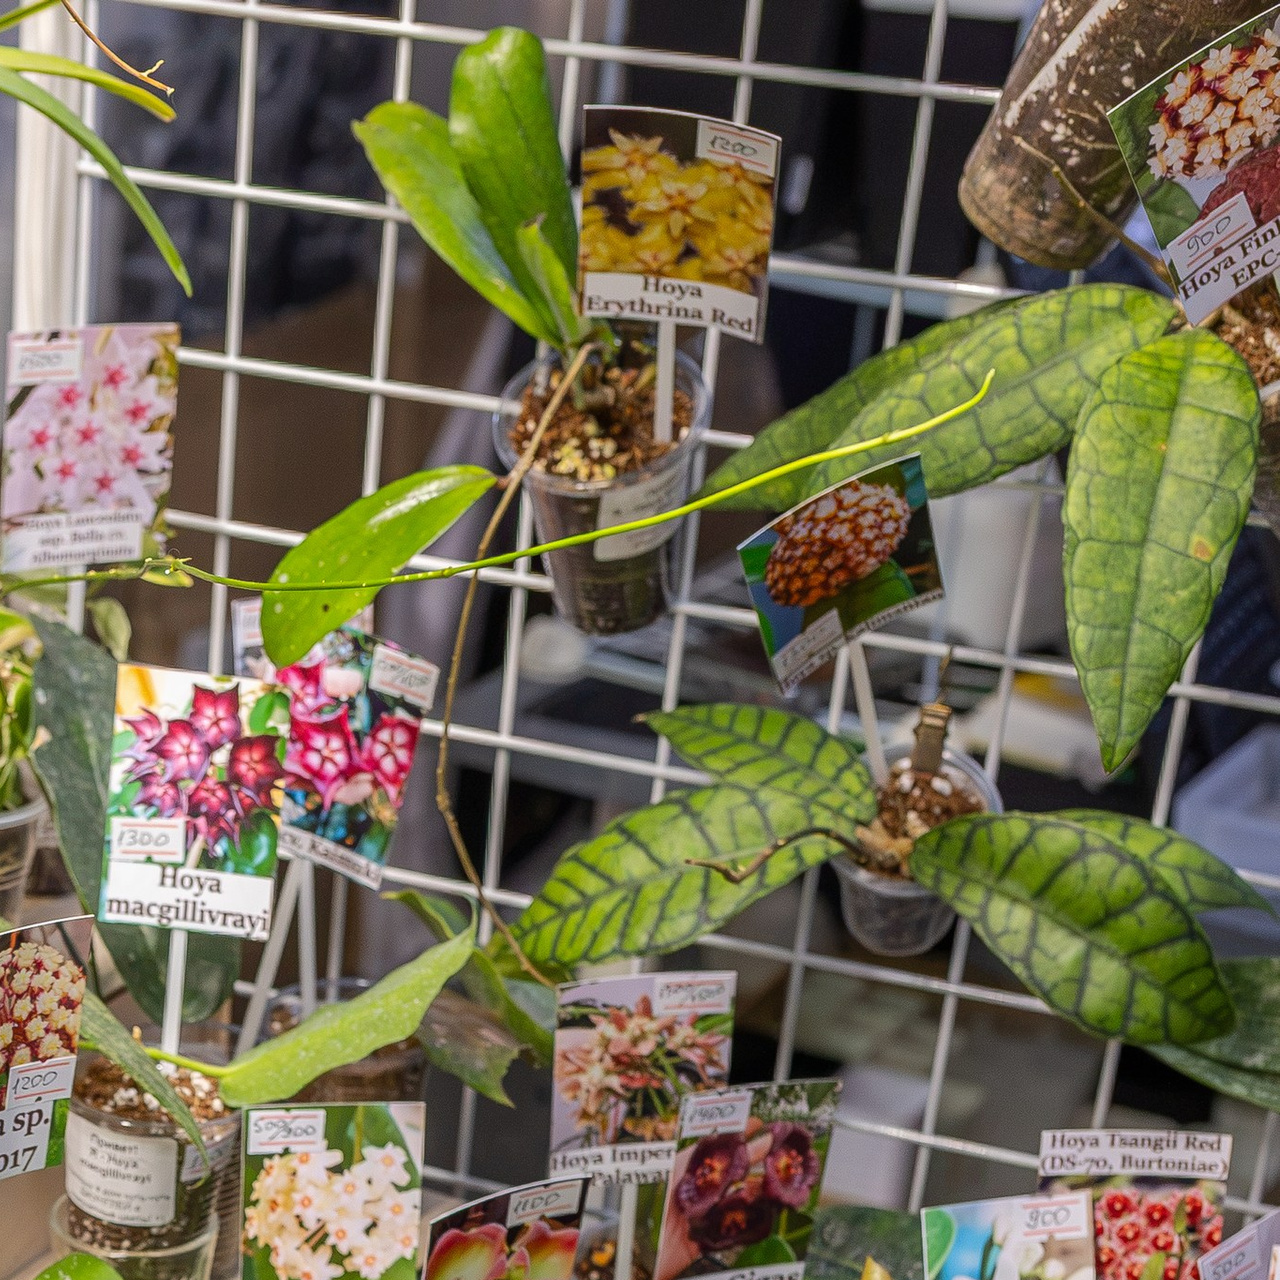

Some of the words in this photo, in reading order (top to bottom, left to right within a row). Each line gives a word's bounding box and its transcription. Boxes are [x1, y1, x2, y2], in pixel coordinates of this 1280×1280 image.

[1180, 256, 1236, 299] Hoya
[1239, 216, 1280, 257] Finl
[1231, 248, 1280, 288] EPC-
[642, 276, 702, 301] Hoya
[586, 297, 705, 324] Erythrina
[712, 307, 753, 335] Red
[117, 829, 171, 850] 1300
[158, 866, 222, 896] Hoya
[107, 897, 270, 940] macgillivrayi
[12, 1070, 58, 1095] 1200
[12, 1102, 50, 1141] sp.
[612, 1146, 677, 1164] Imper
[1051, 1133, 1100, 1152] Hoya
[1186, 1135, 1221, 1152] Red
